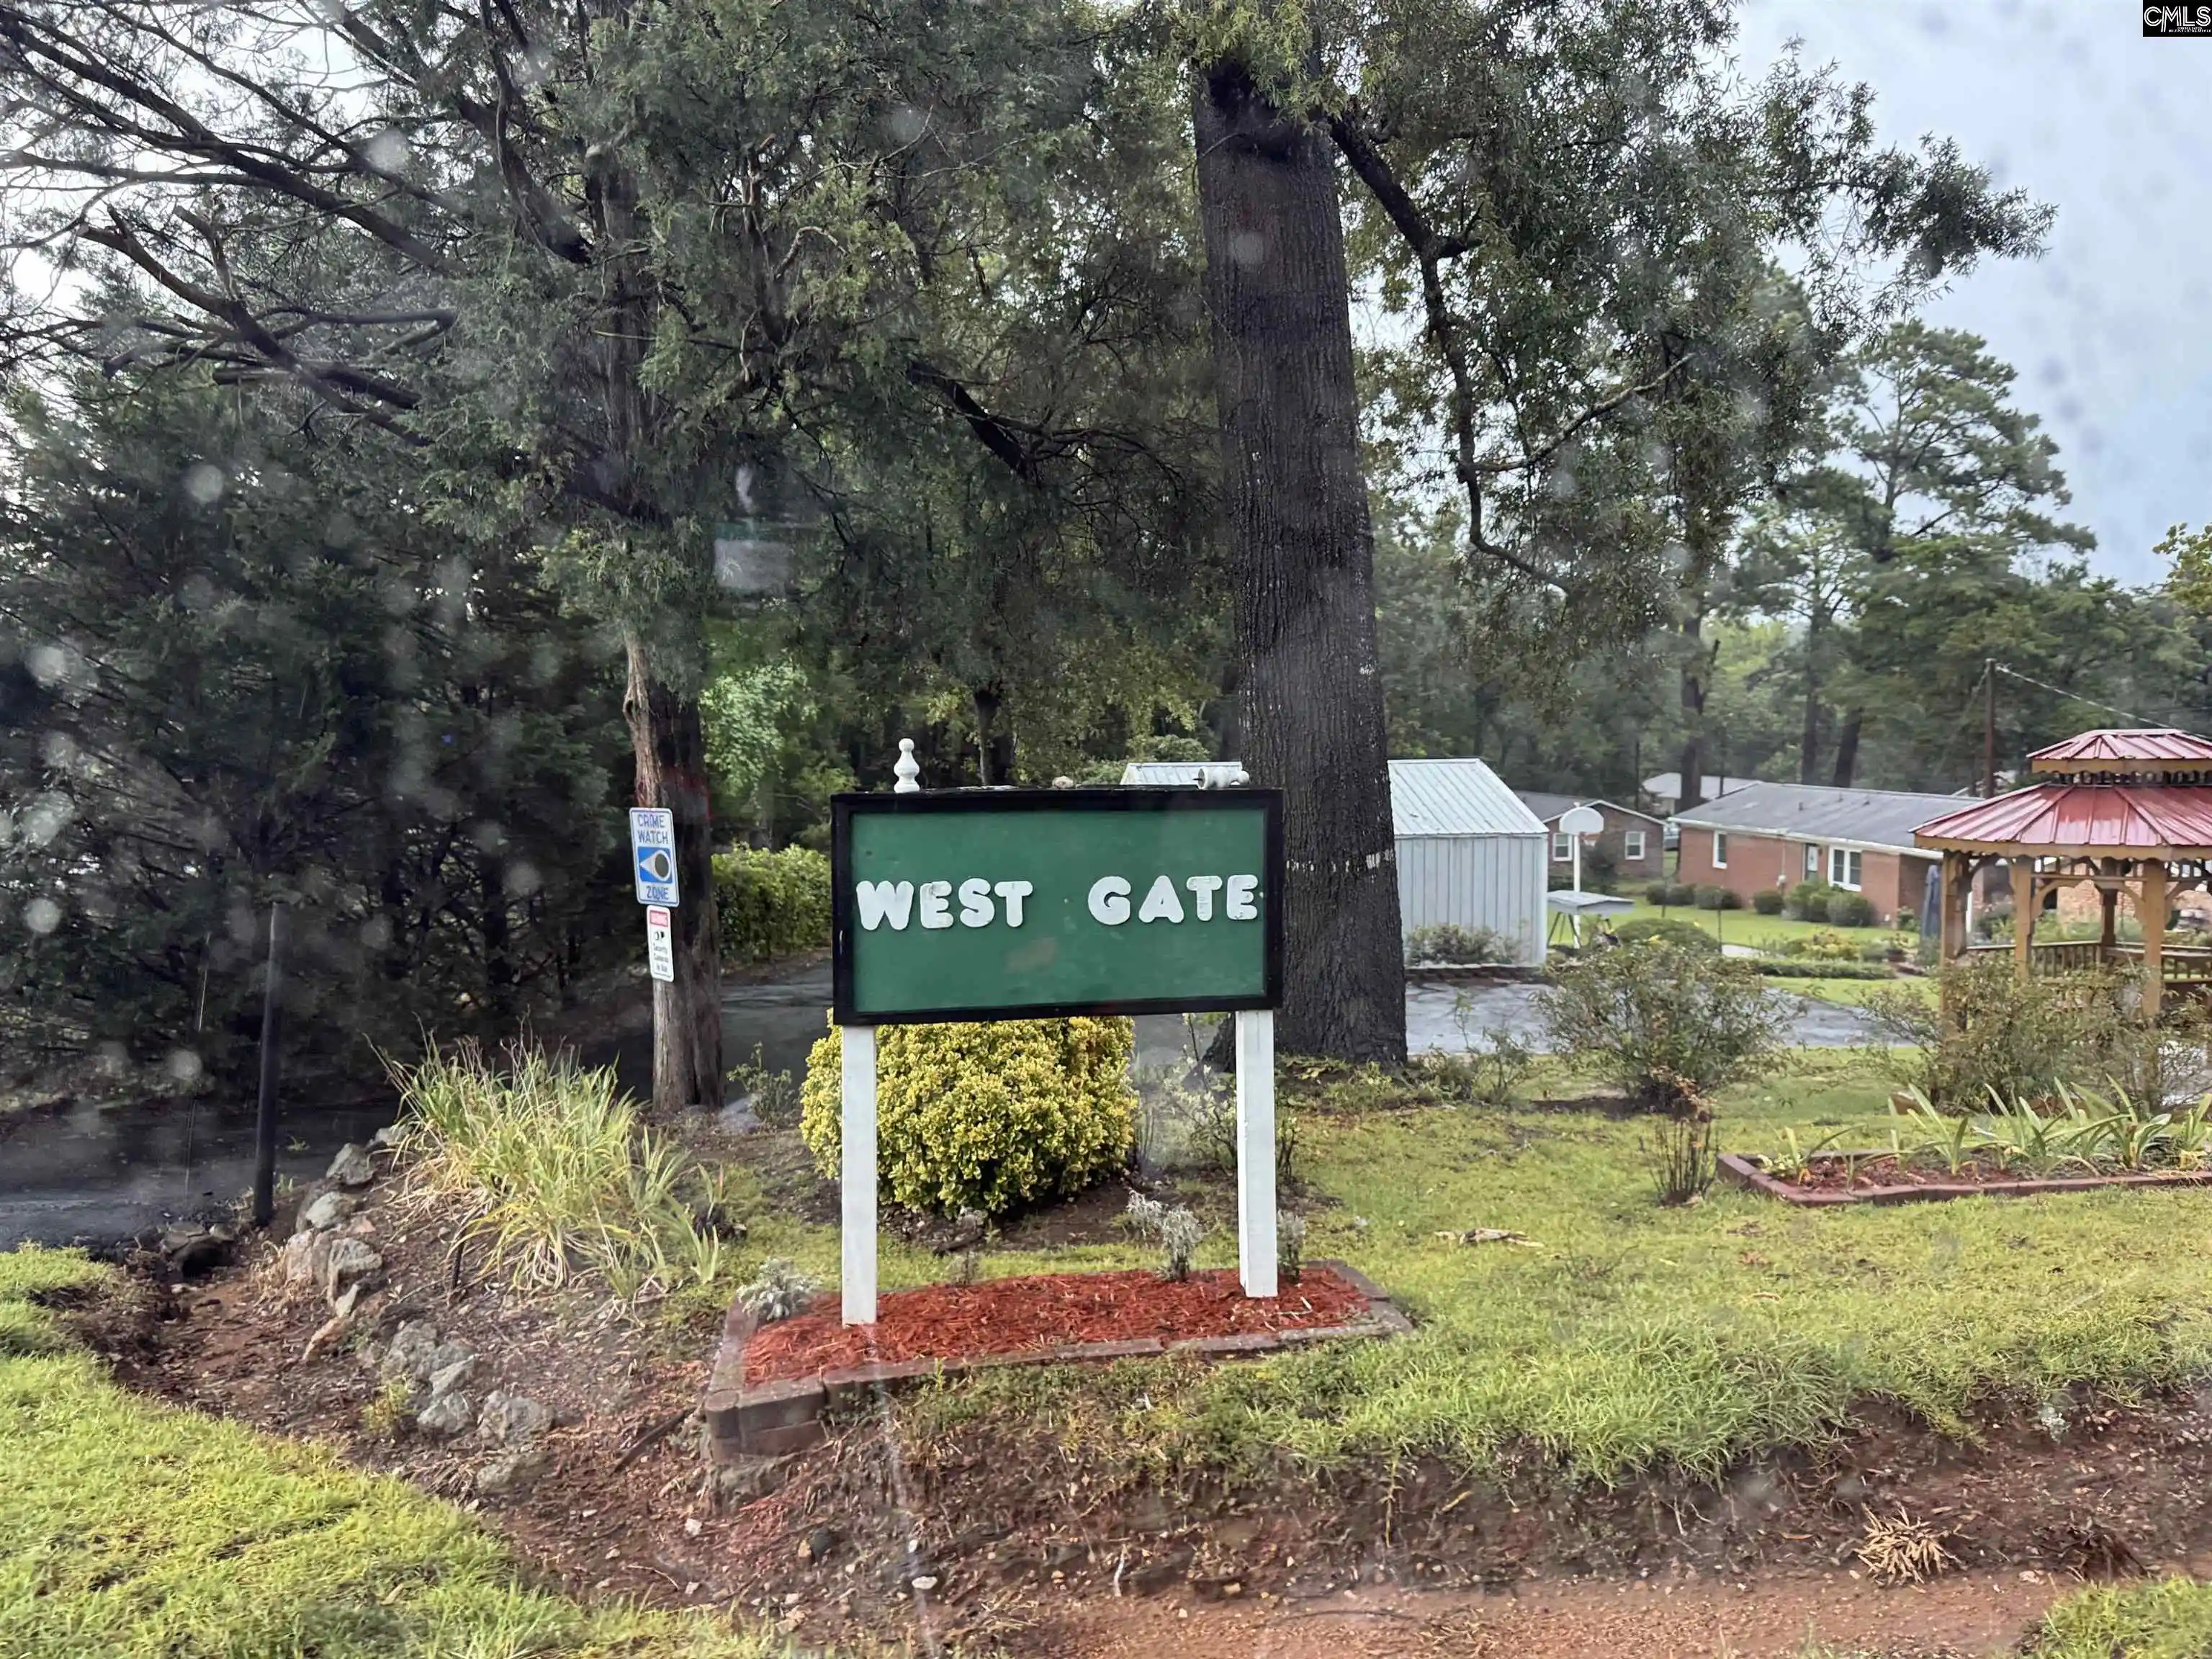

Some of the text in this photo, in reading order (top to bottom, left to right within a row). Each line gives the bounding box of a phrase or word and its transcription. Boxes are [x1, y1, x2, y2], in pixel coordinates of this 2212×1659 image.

[637, 814, 665, 828] CRIME
[637, 830, 668, 845] WATCH
[646, 886, 669, 900] ZONE
[855, 874, 1259, 931] WEST GATE
